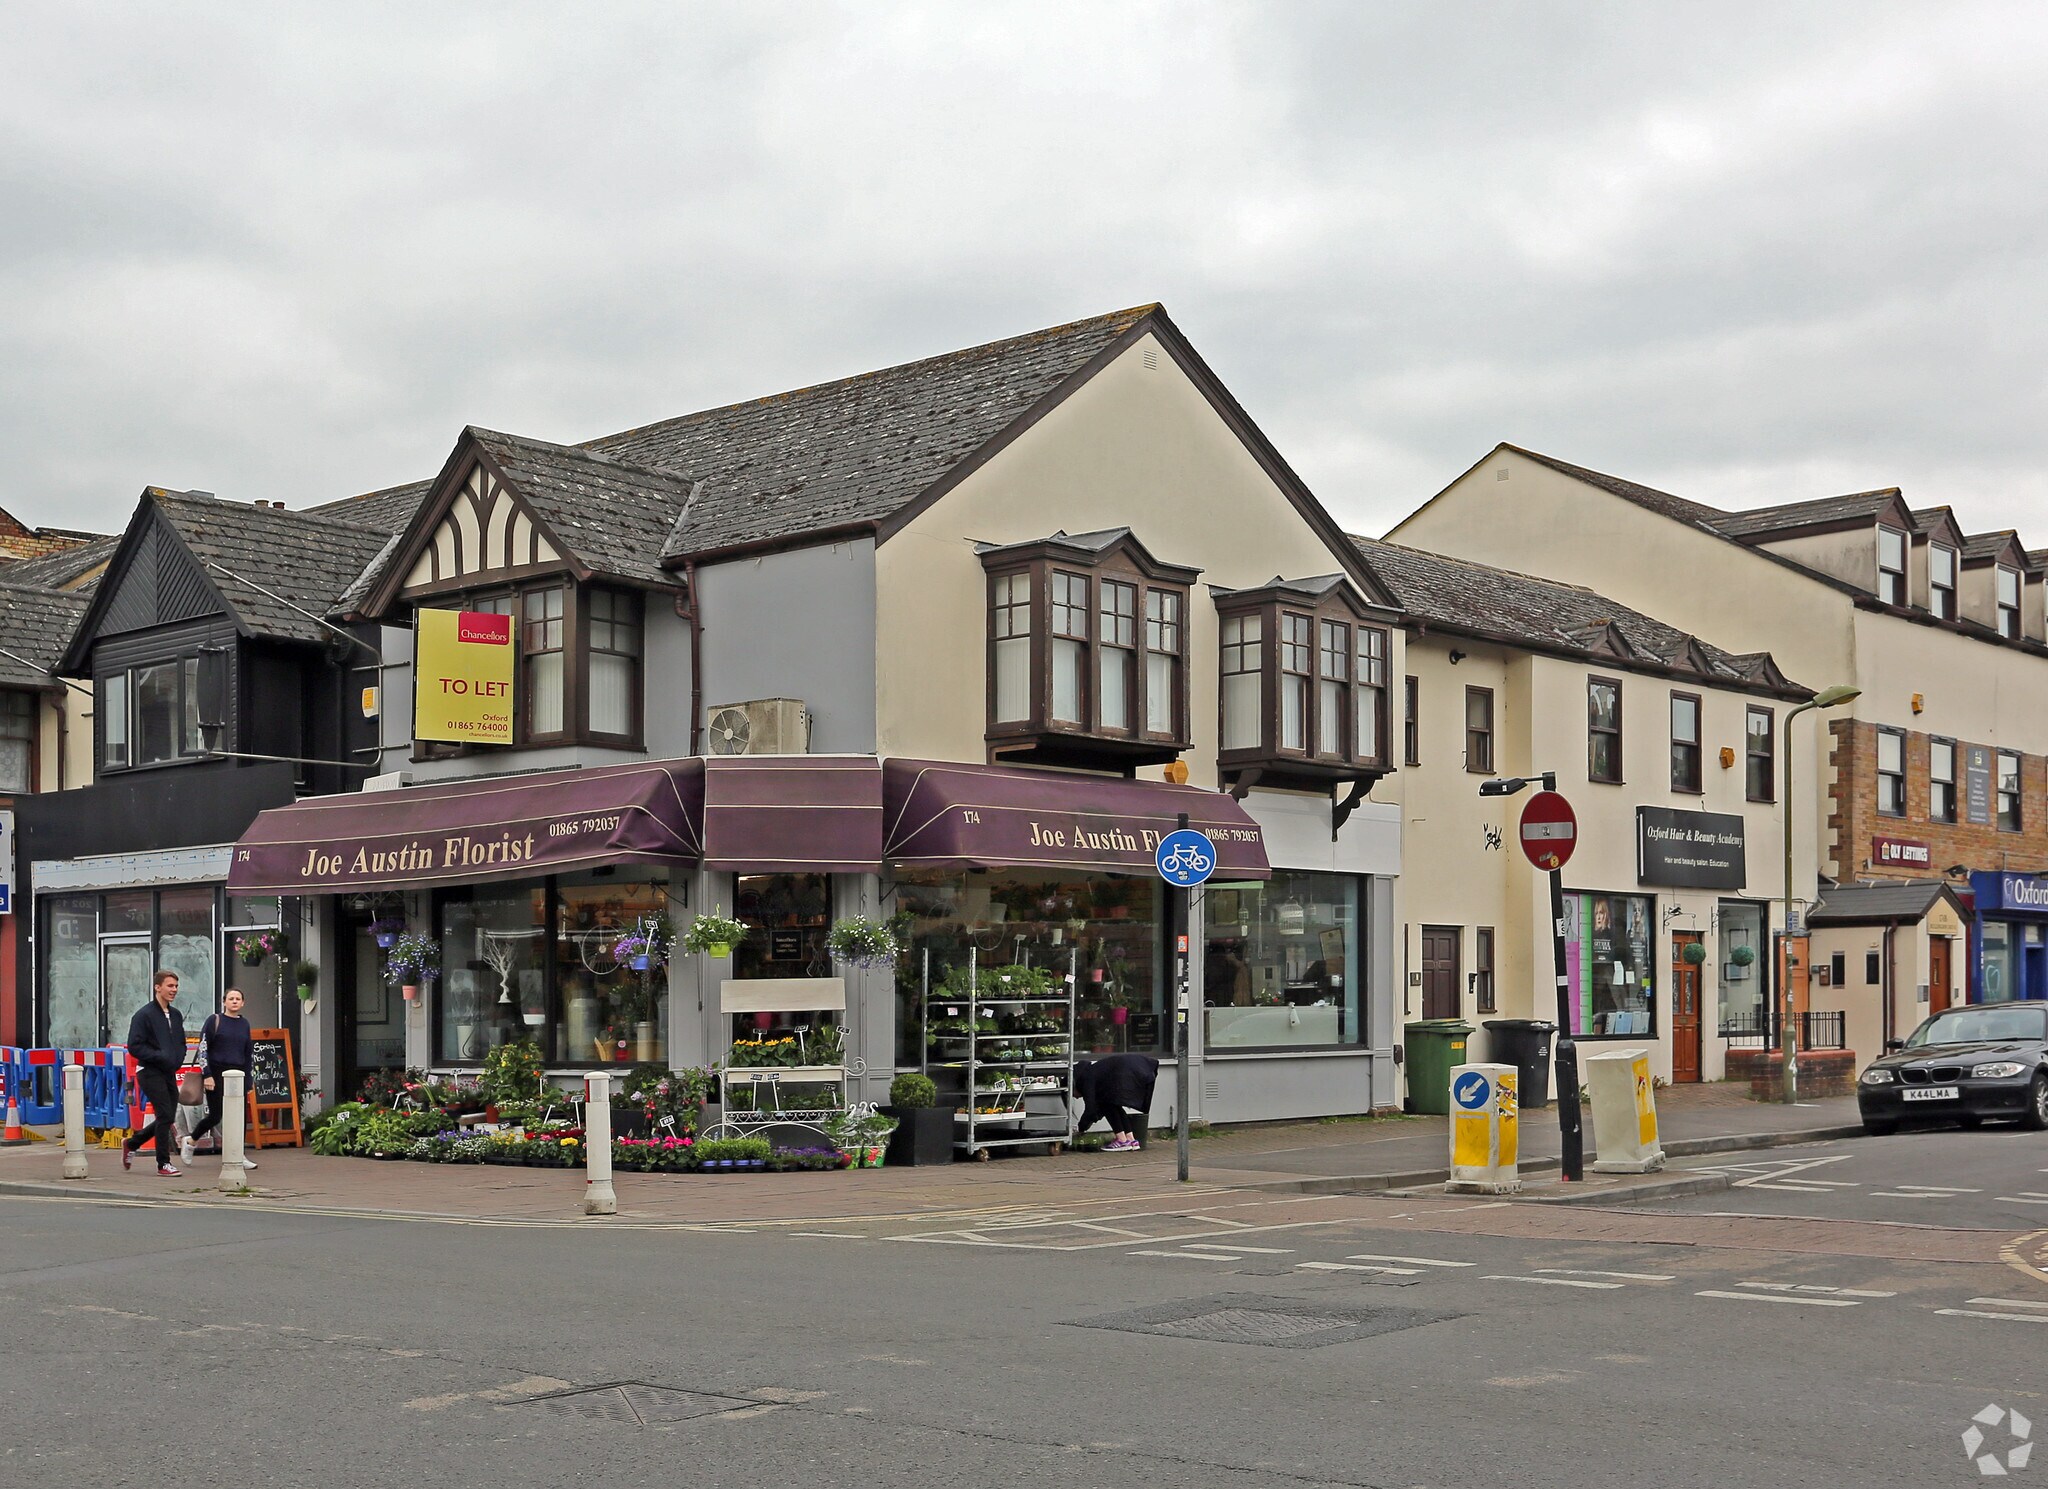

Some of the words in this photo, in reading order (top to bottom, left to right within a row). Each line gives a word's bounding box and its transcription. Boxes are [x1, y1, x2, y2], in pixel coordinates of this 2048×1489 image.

[461, 629, 507, 641] Chancellors
[439, 678, 468, 694] TO
[475, 681, 509, 697] LET
[482, 714, 508, 722] Oxford
[447, 721, 474, 730] 01865
[477, 722, 508, 732] 764000
[963, 810, 980, 824] 174
[549, 821, 579, 837] 01865
[582, 816, 620, 833] 792037
[1030, 822, 1065, 847] Joe
[1073, 825, 1138, 851] Austin
[1205, 828, 1230, 841] 01865
[1231, 830, 1259, 842] 792037
[1647, 826, 1669, 841] Oxford
[1670, 828, 1685, 840] Hair
[1686, 830, 1692, 841] &
[1694, 830, 1716, 846] Beauty
[1716, 833, 1743, 848] Academy
[237, 850, 250, 862] 174
[301, 848, 343, 876] Joe
[349, 841, 433, 874] Austin
[442, 832, 535, 868] Florist
[1910, 1089, 1950, 1100] K44LMA
